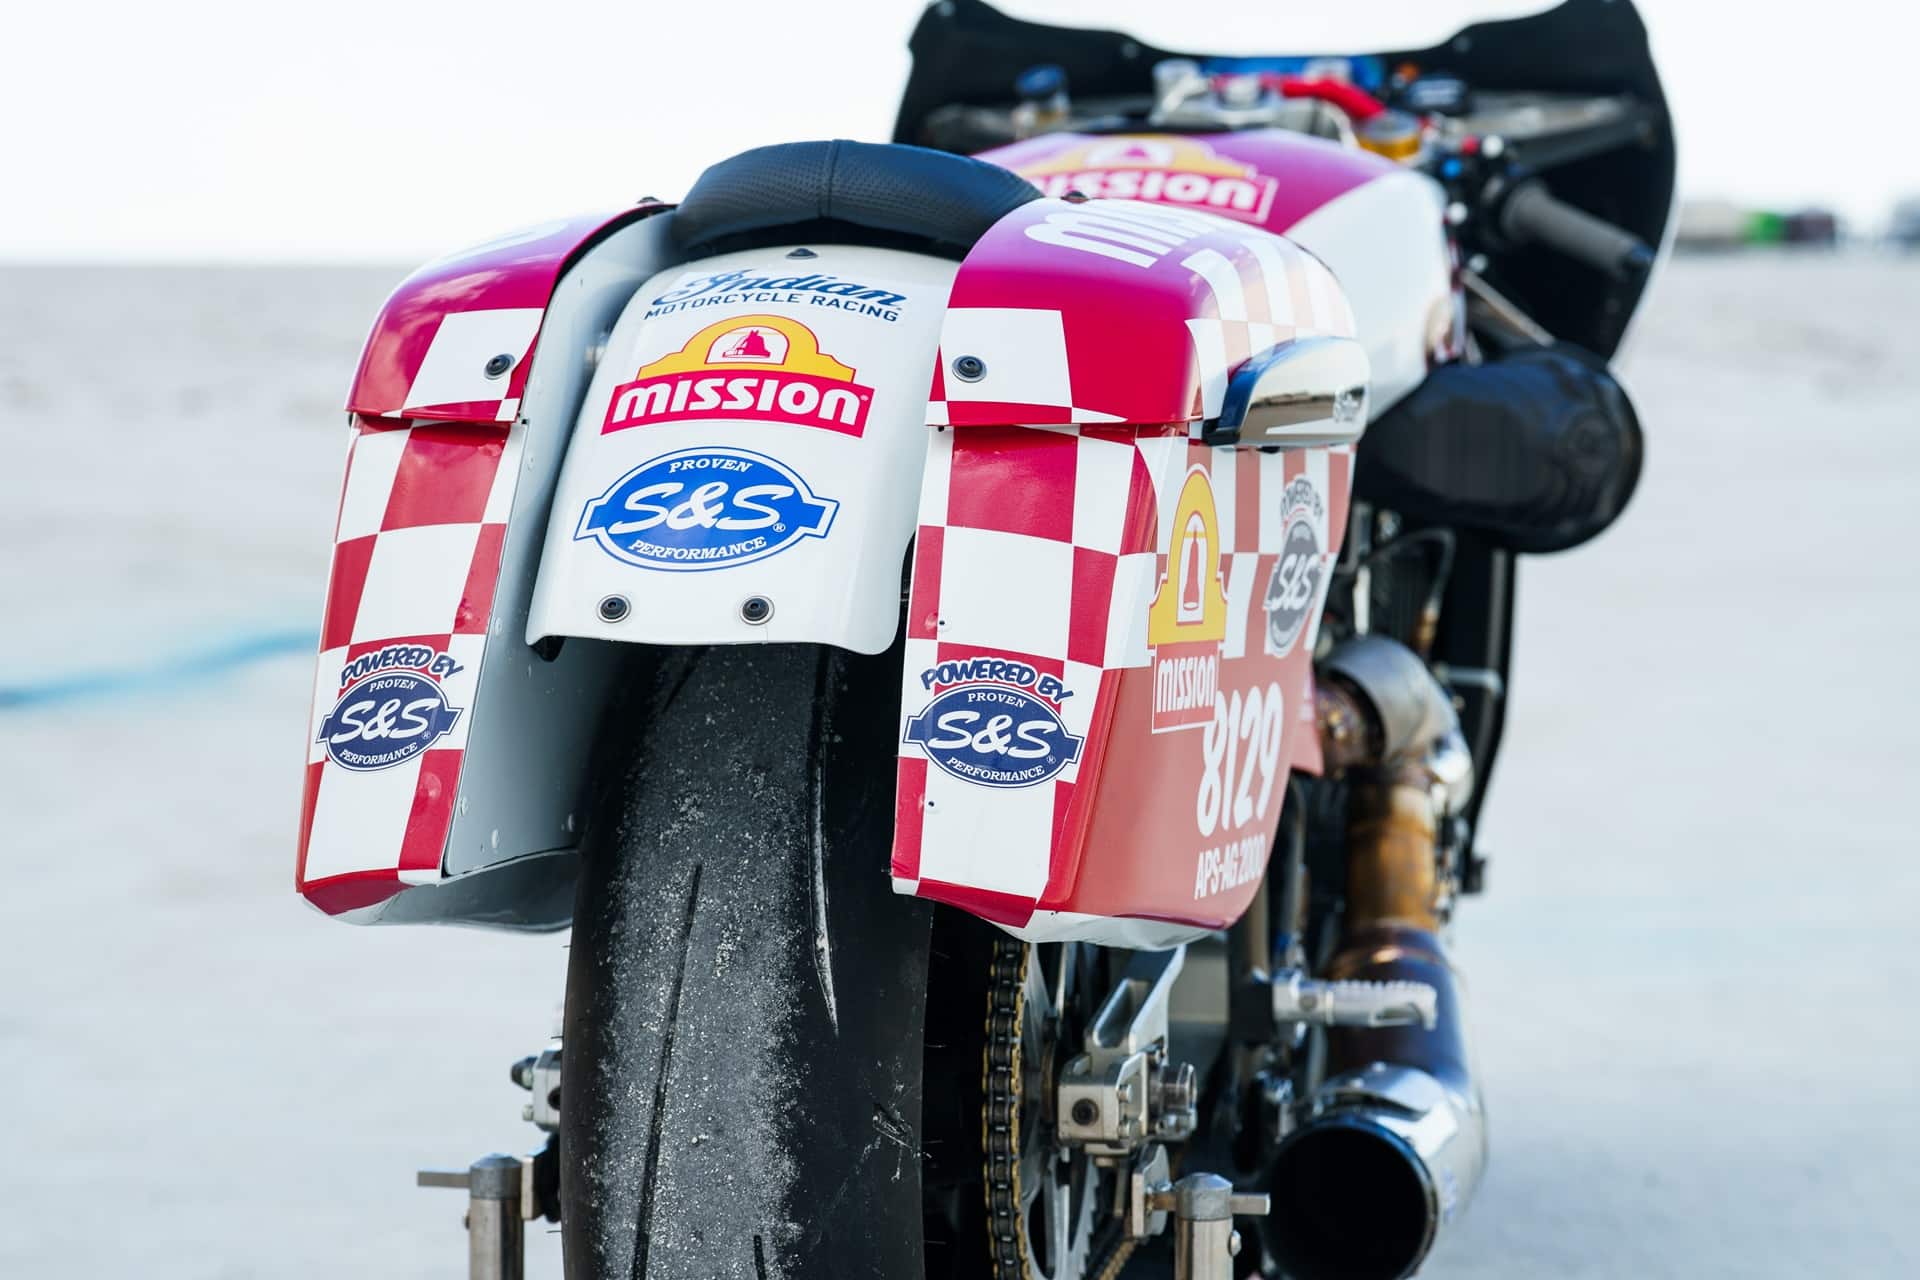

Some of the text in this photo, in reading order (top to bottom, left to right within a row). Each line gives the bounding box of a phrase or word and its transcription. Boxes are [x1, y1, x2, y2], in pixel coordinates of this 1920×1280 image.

[652, 269, 907, 307] Indian
[643, 292, 899, 322] MOTORCYCLE RACING
[669, 458, 752, 474] PROVEN
[608, 481, 795, 534] S&S
[628, 536, 767, 560] PERFORMANCE
[340, 646, 464, 687] POWERED BY
[921, 659, 1074, 703] POWERED BY
[369, 679, 418, 692] PROVEN
[968, 692, 1026, 708] PROVEN
[330, 698, 441, 744] S&S
[927, 710, 1058, 759] S&S
[339, 742, 417, 765] PERFORMANCE
[946, 756, 1045, 782] PERFORMANCE
[1197, 681, 1283, 837] 8129
